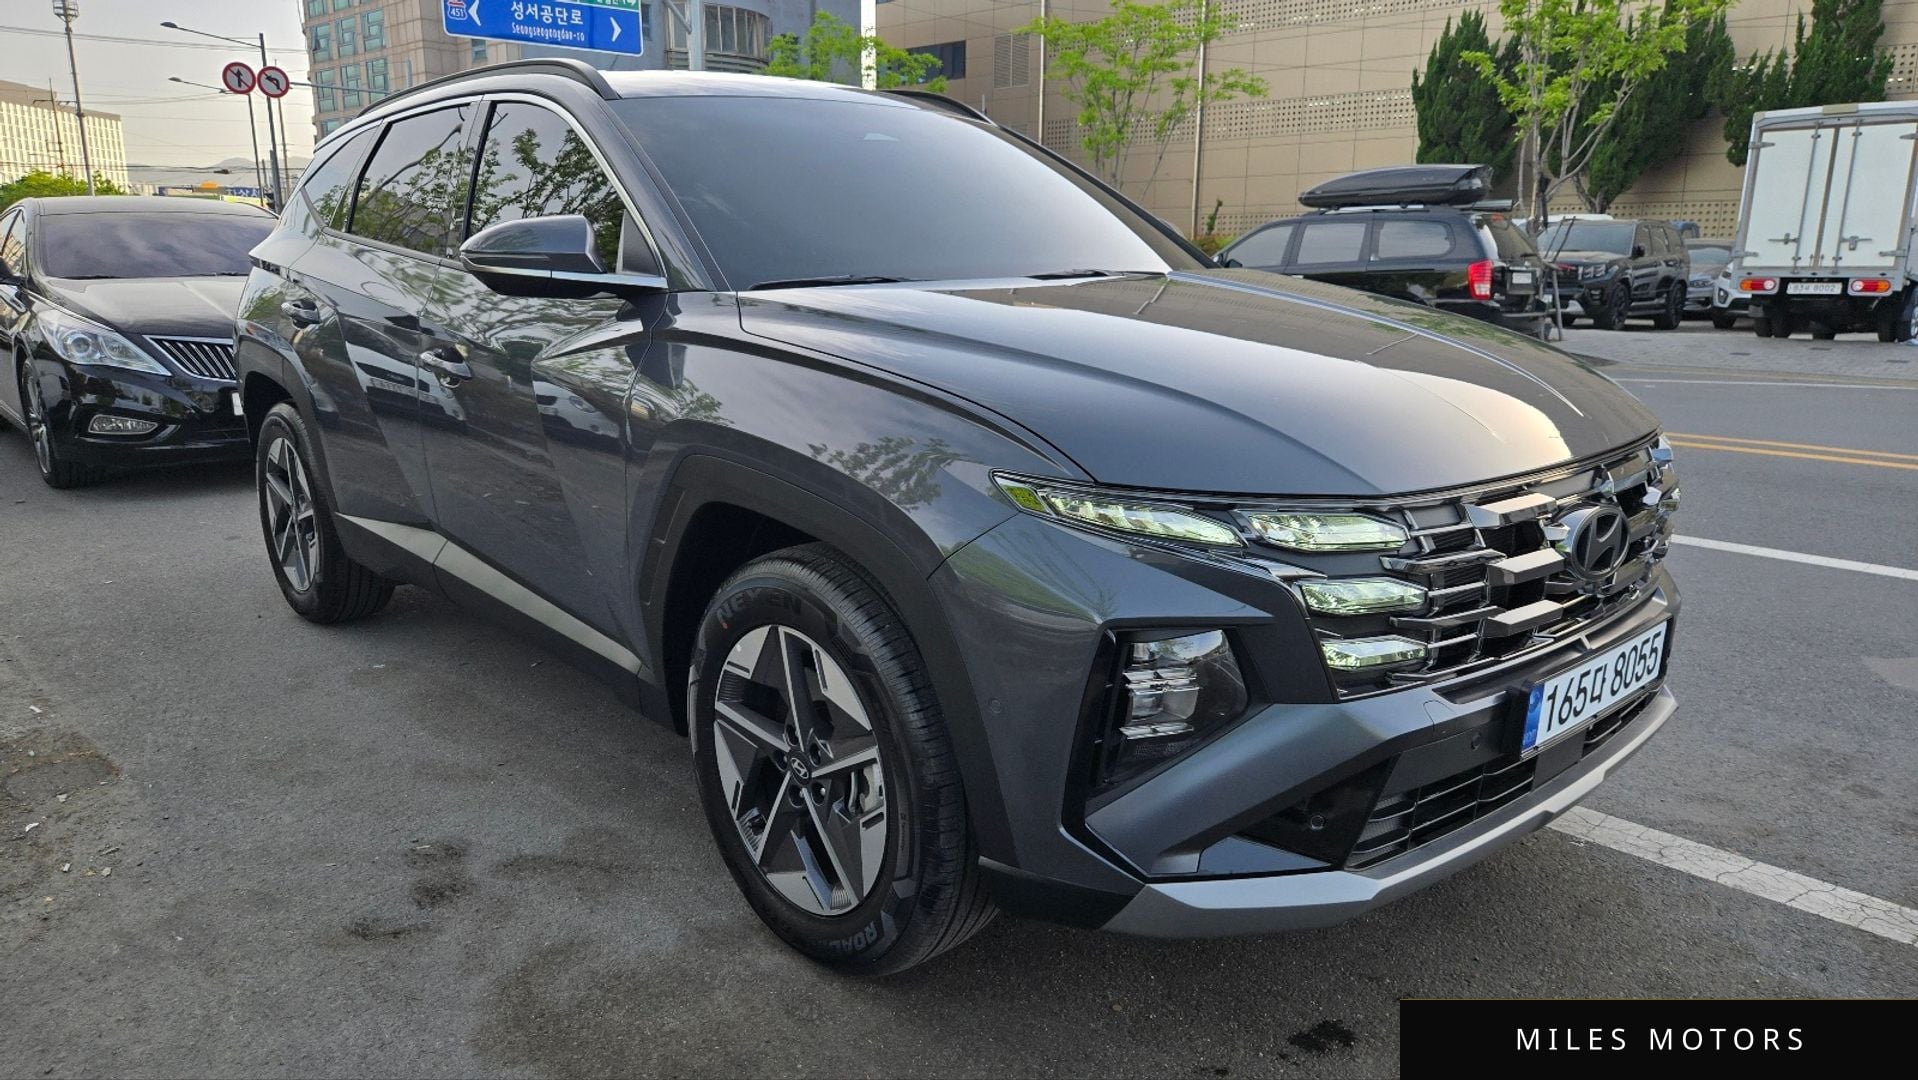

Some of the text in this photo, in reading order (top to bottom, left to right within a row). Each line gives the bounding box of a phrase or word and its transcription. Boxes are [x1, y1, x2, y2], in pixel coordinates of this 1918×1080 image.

[450, 7, 464, 17] 451
[510, 1, 583, 26] 성서공단로
[1546, 630, 1662, 732] 165마 8055
